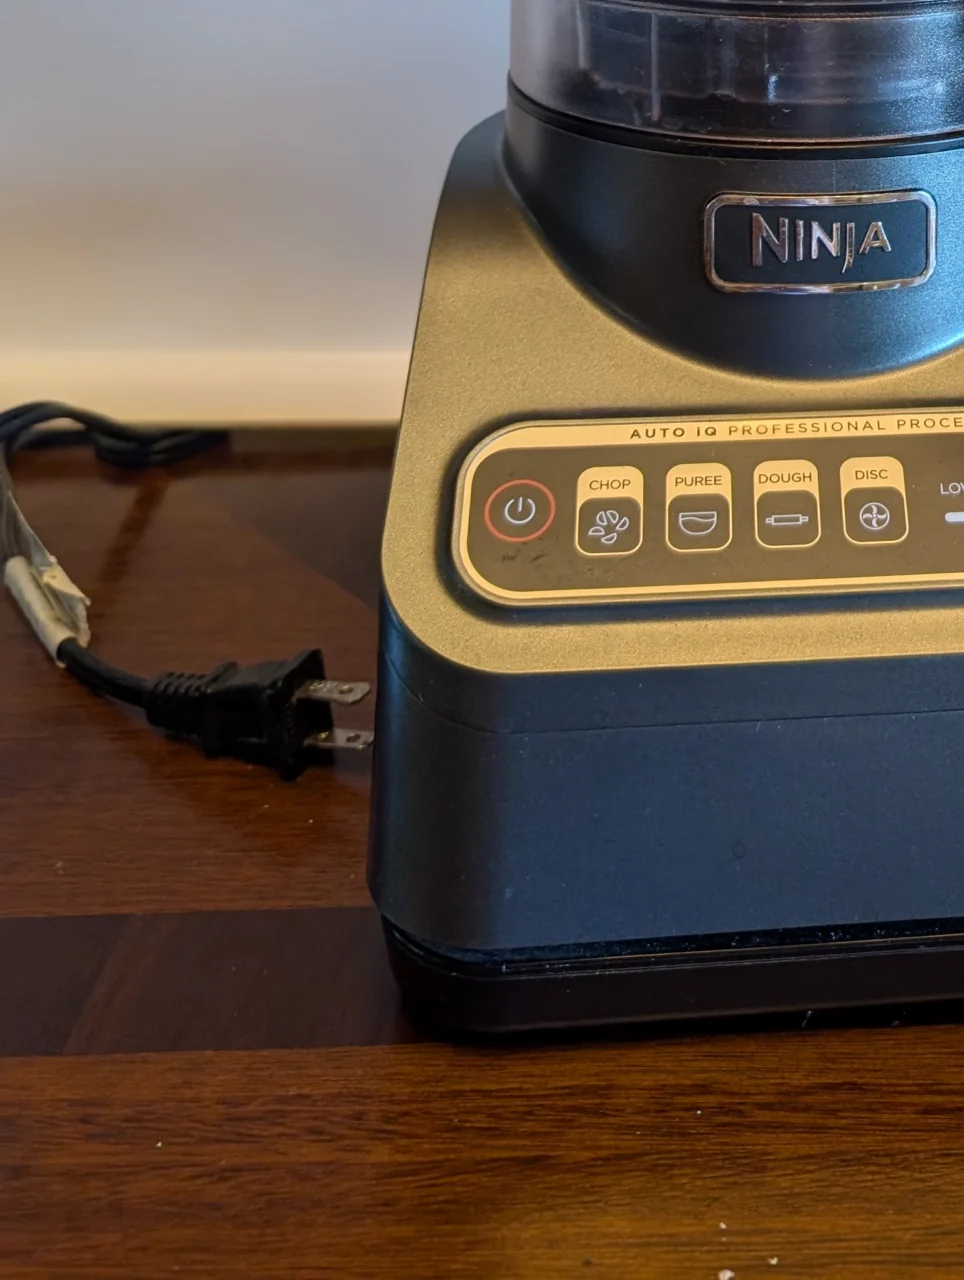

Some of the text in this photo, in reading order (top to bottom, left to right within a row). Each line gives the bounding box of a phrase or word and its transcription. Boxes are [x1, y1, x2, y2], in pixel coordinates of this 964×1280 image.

[751, 212, 892, 274] NINJA
[629, 427, 686, 439] AUTO
[728, 420, 887, 436] PROFESSIONAL
[674, 475, 723, 487] PUREE
[758, 472, 813, 484] DOUGH
[854, 468, 889, 481] DISC
[588, 478, 632, 491] CHOP
